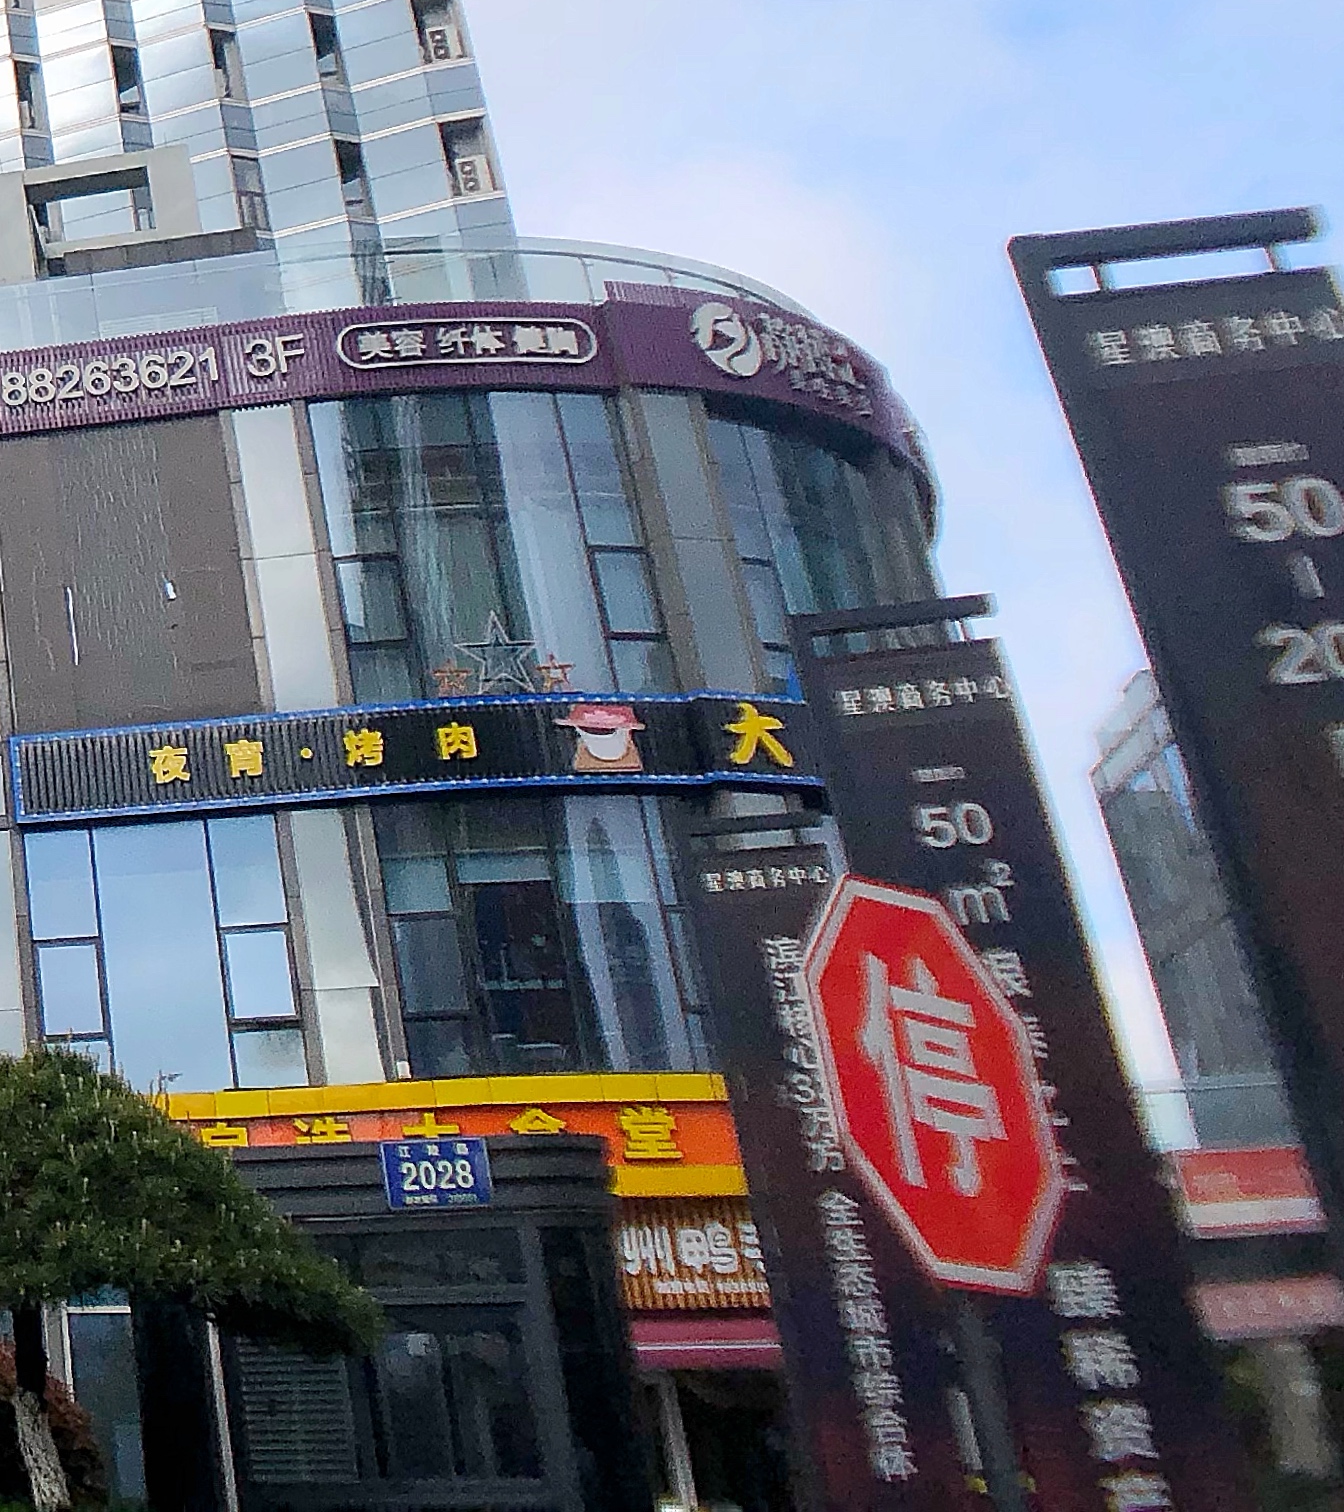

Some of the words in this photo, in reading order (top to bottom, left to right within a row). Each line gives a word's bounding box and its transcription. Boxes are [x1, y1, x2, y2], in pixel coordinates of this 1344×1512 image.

[1, 346, 219, 406] 88263621
[246, 333, 306, 378] 3F
[358, 329, 427, 360] 美容
[436, 325, 506, 355] 纤体
[1220, 474, 1344, 541] 50
[148, 720, 478, 785] 夜宵·烤肉
[723, 702, 795, 769] 大
[917, 802, 994, 849] 50
[857, 948, 1010, 1198] 停
[400, 1160, 475, 1191] 2028
